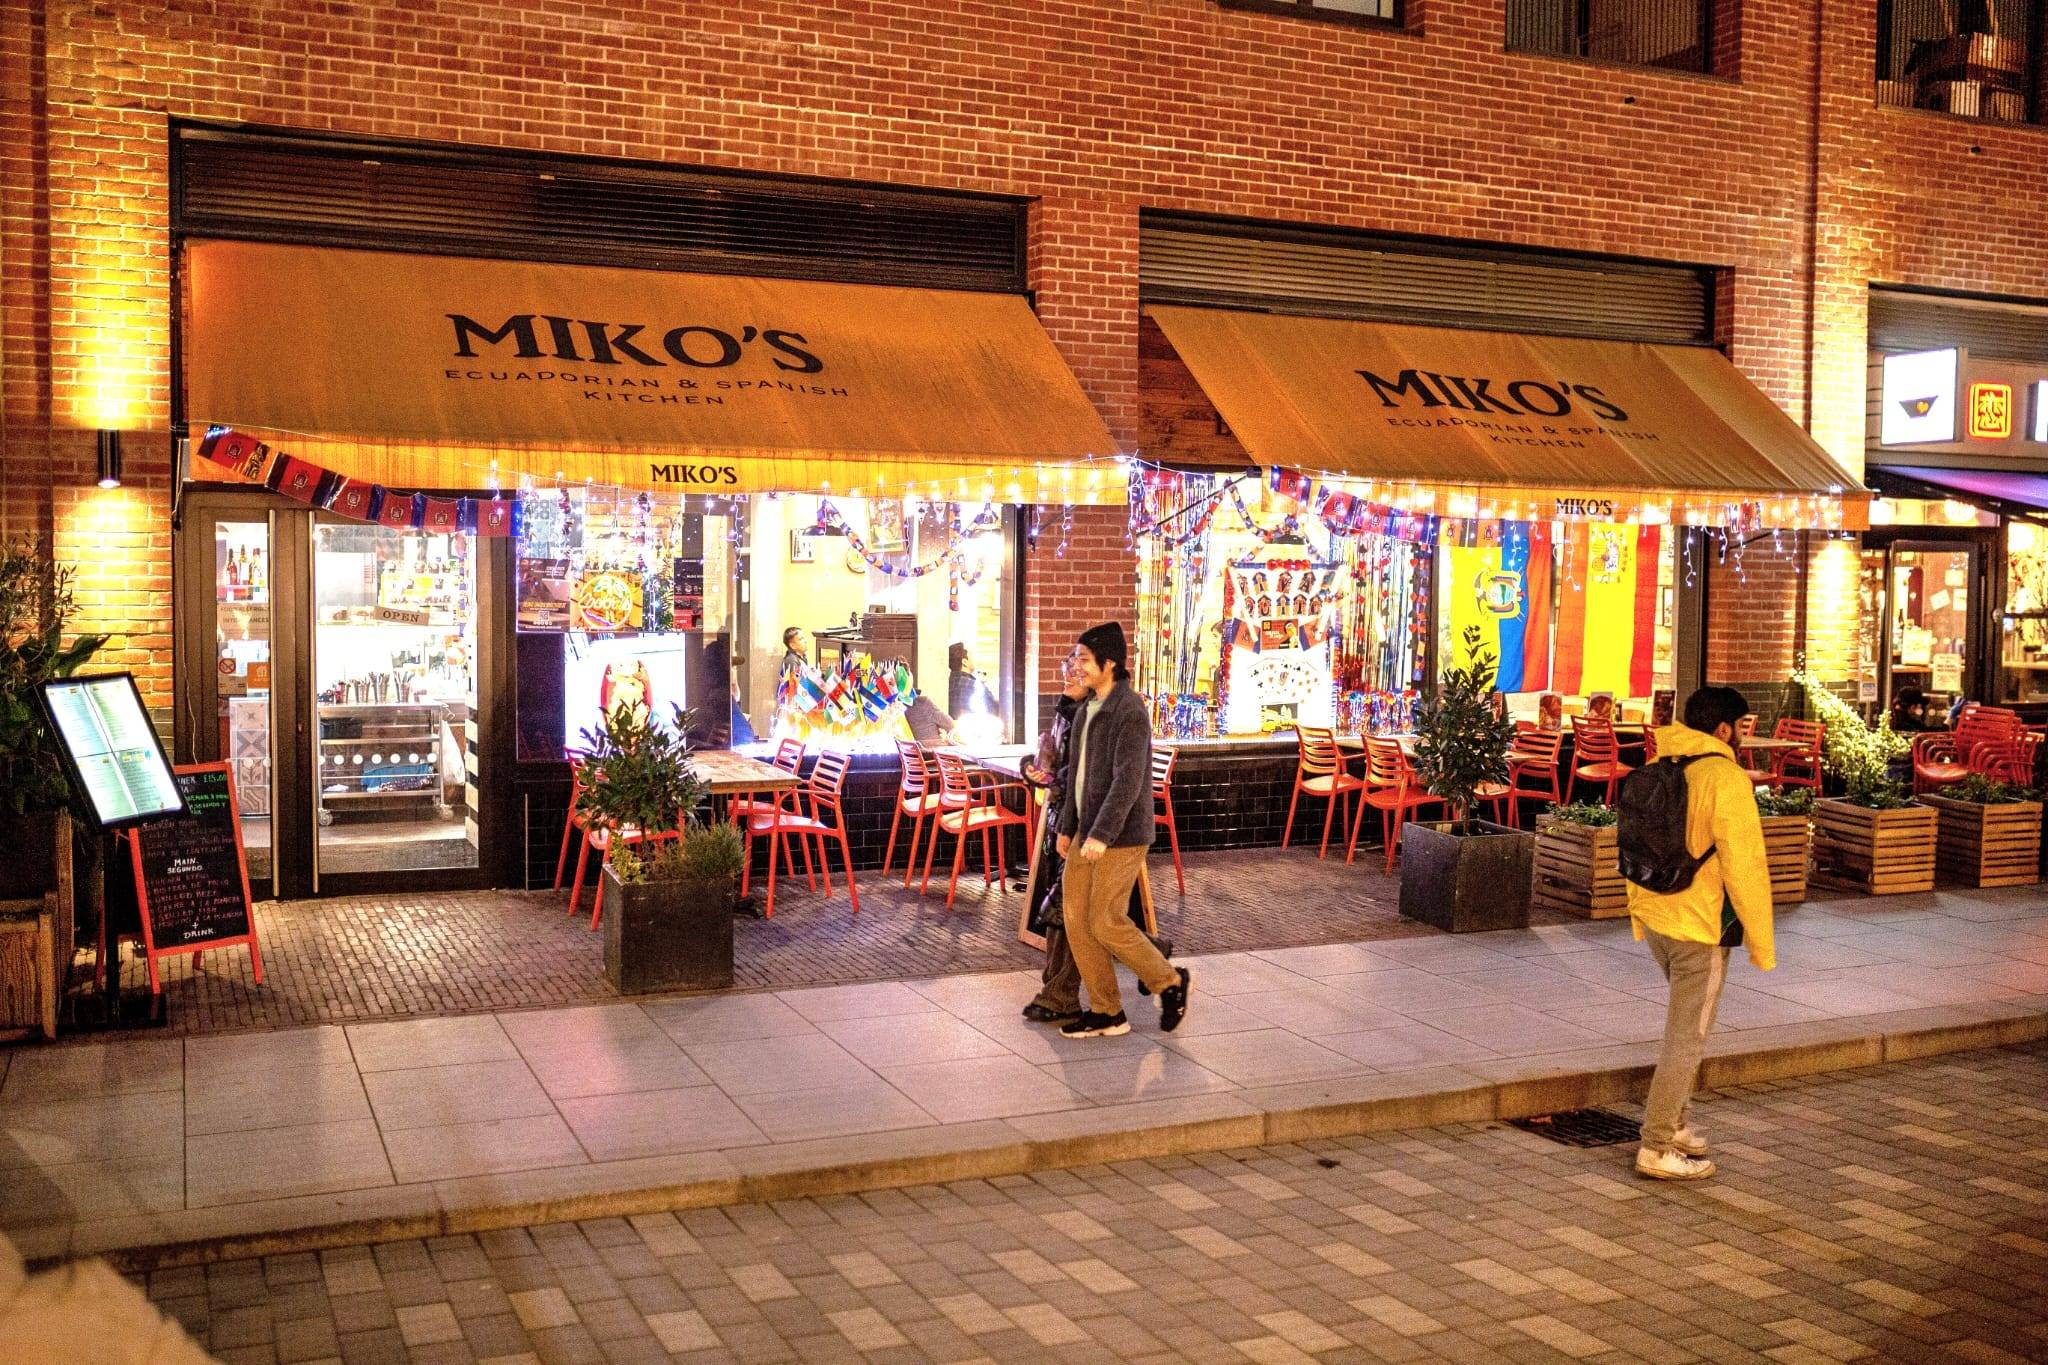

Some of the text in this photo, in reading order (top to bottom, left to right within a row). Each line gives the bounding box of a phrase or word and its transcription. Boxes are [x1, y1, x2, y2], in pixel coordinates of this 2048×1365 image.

[445, 313, 824, 374] MIKO'S
[445, 369, 849, 398] ECUADORIAN & SPANISH
[584, 390, 725, 405] KITCHEN
[1355, 369, 1629, 422] MIKO'S
[1387, 418, 1660, 441] ECUADORIAN & SPANISH
[1489, 435, 1585, 449] KITCHEN
[650, 463, 738, 485] MIKO'S
[1556, 498, 1613, 516] MIKO'S
[383, 610, 421, 623] OPEN
